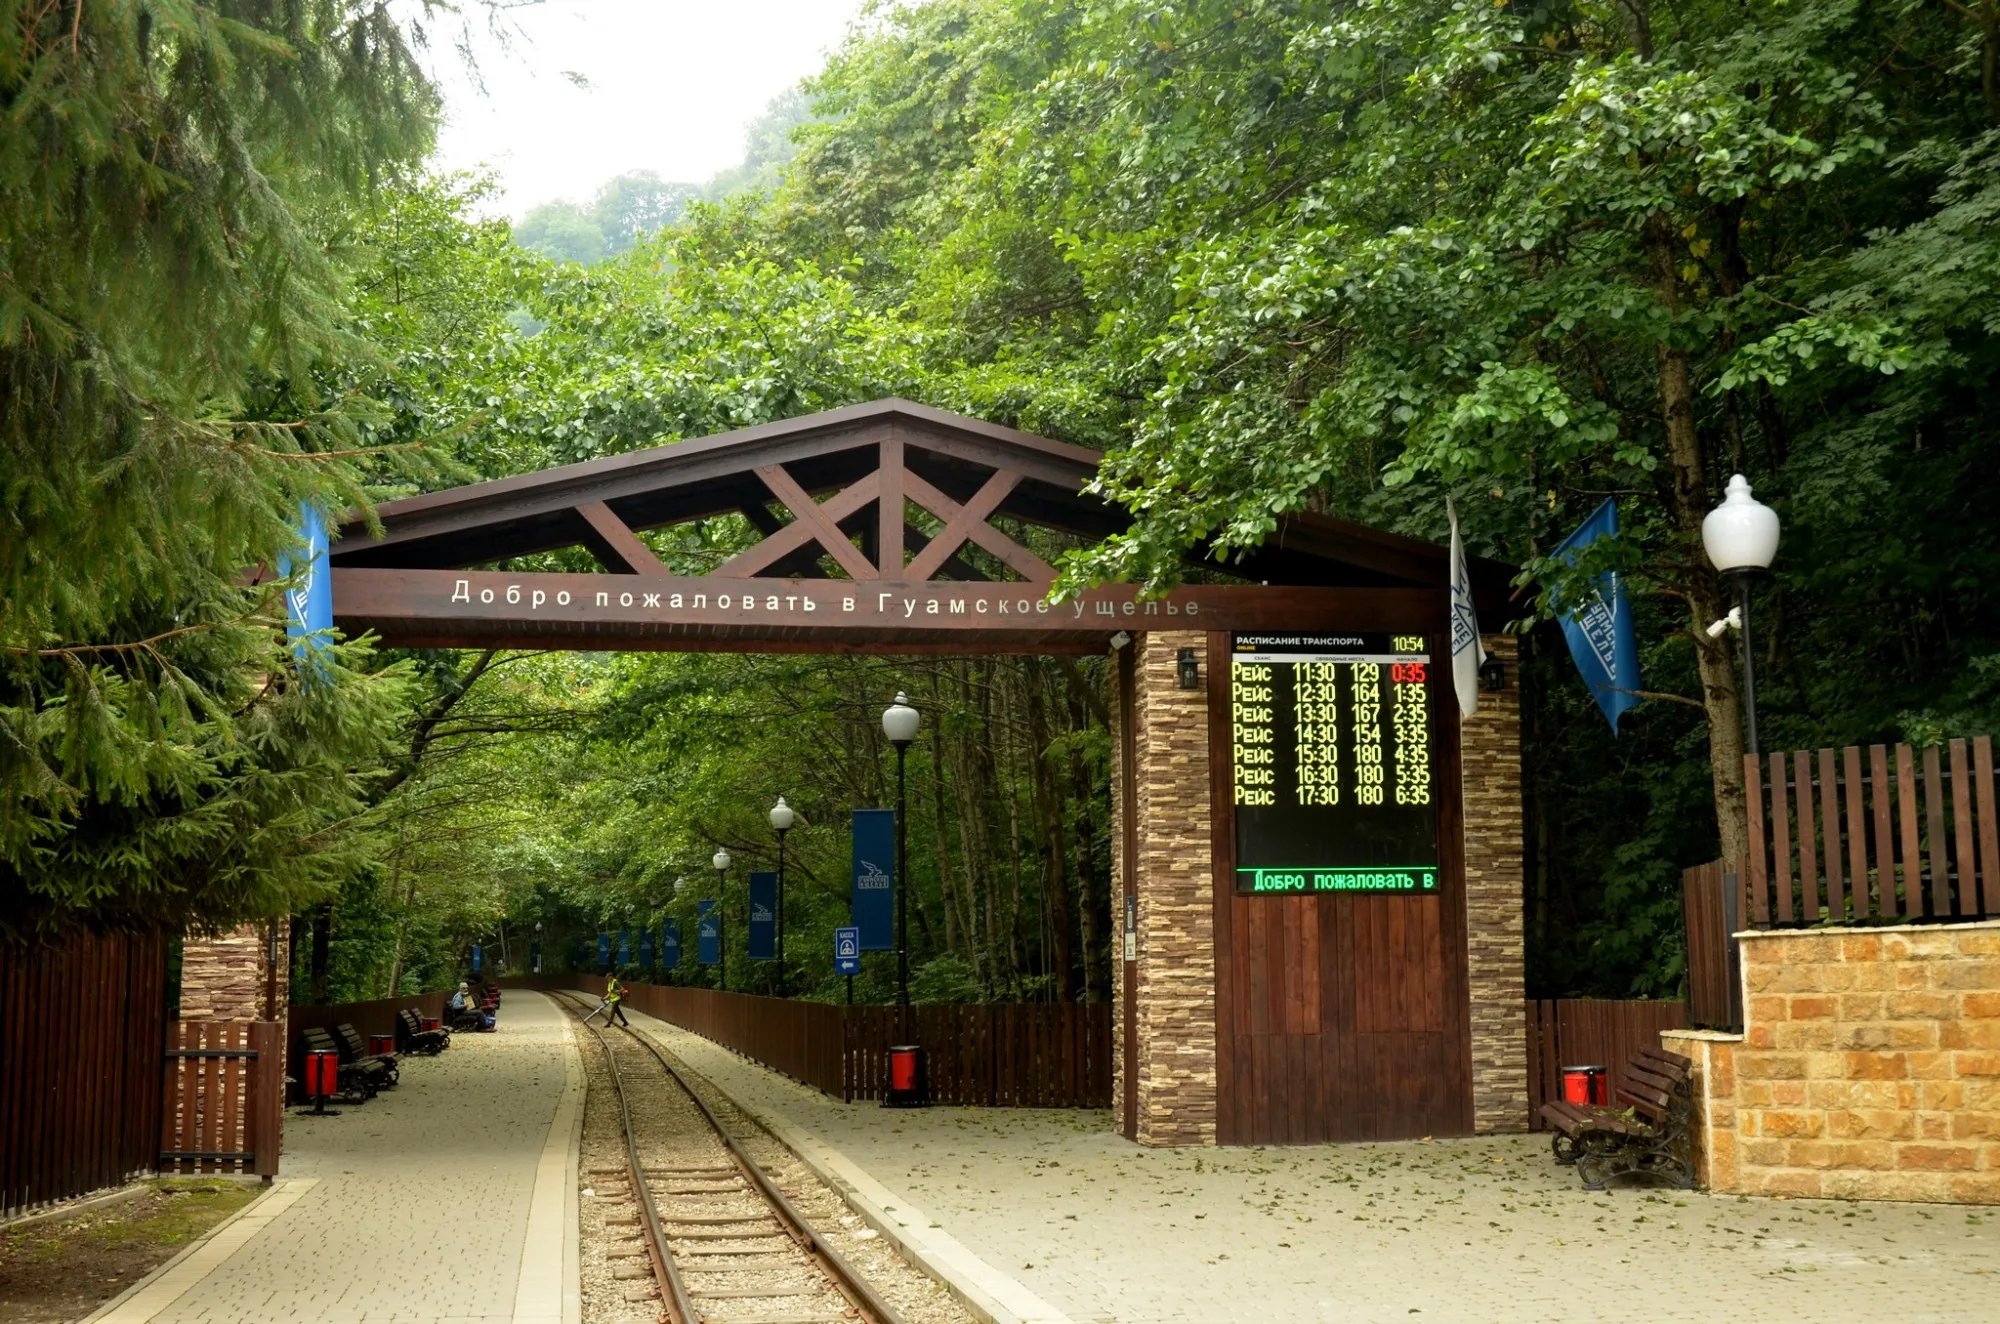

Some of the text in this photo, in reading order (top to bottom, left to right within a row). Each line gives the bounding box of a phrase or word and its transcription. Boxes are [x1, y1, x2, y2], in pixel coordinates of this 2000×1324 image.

[451, 579, 1199, 619] Добро пожаловать в Гуамское ущелье
[1236, 636, 1364, 646] РАСПИСАНИЕ ТРАНСПОРТА
[1393, 636, 1424, 652] 10:54
[1292, 662, 1335, 682] 11:30
[1350, 662, 1380, 682] 129
[1391, 662, 1426, 682] 0:35
[1292, 682, 1336, 702] 12:30
[1350, 682, 1380, 702] 164
[1393, 682, 1426, 702] 1:35
[1293, 703, 1336, 723] 13:30
[1351, 703, 1381, 723] 167
[1393, 703, 1427, 723] 2:35
[1294, 723, 1337, 743] 14:30
[1352, 723, 1381, 743] 154
[1394, 723, 1428, 743] 3:35
[1294, 744, 1338, 764] 15:30
[1353, 744, 1382, 764] 180
[1394, 744, 1428, 764] 4:35
[1295, 764, 1338, 784] 16:30
[1354, 764, 1384, 784] 180
[1396, 764, 1430, 784] 5:35
[1296, 785, 1339, 805] 17:30
[1354, 785, 1383, 805] 180
[1395, 785, 1430, 805] 6:35
[1254, 870, 1434, 891] Добро пожаловать в
